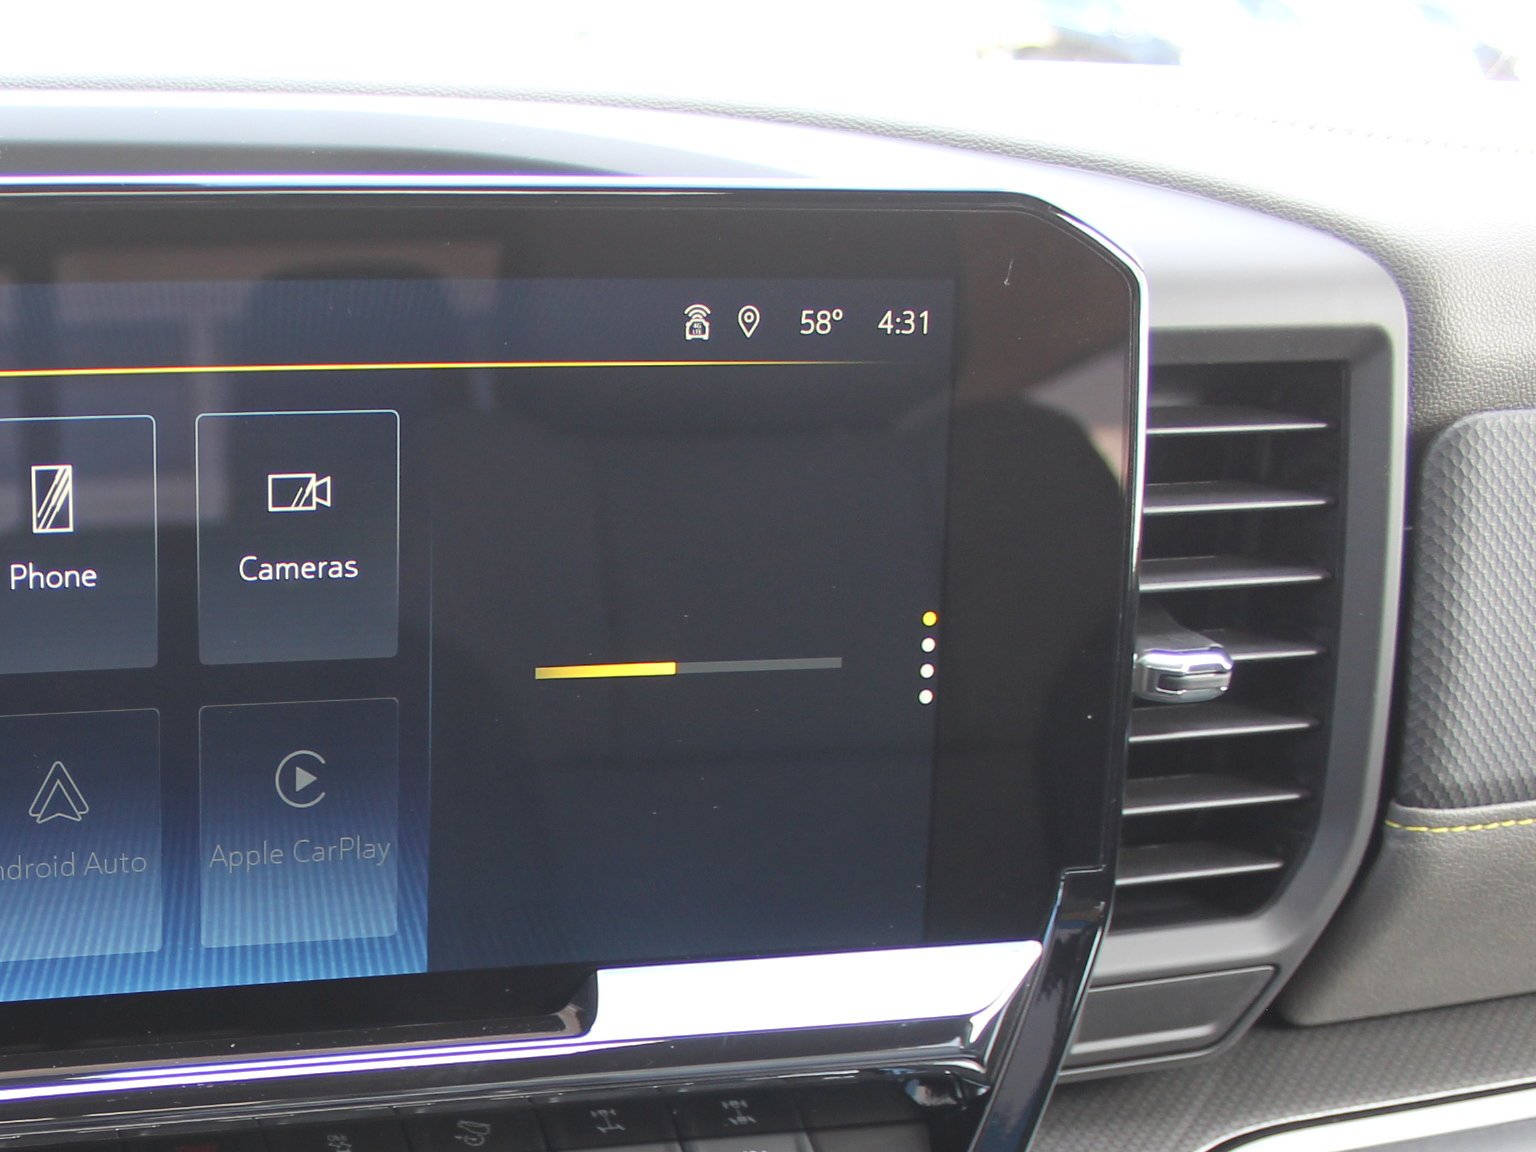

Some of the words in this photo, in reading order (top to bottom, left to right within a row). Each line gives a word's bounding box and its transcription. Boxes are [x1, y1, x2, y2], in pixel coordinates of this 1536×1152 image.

[877, 310, 929, 335] 4:31
[8, 562, 97, 593] Phone
[238, 554, 358, 584] Cameras
[84, 850, 147, 878] Auto
[209, 841, 285, 871] Apple
[293, 836, 391, 868] CarPlay
